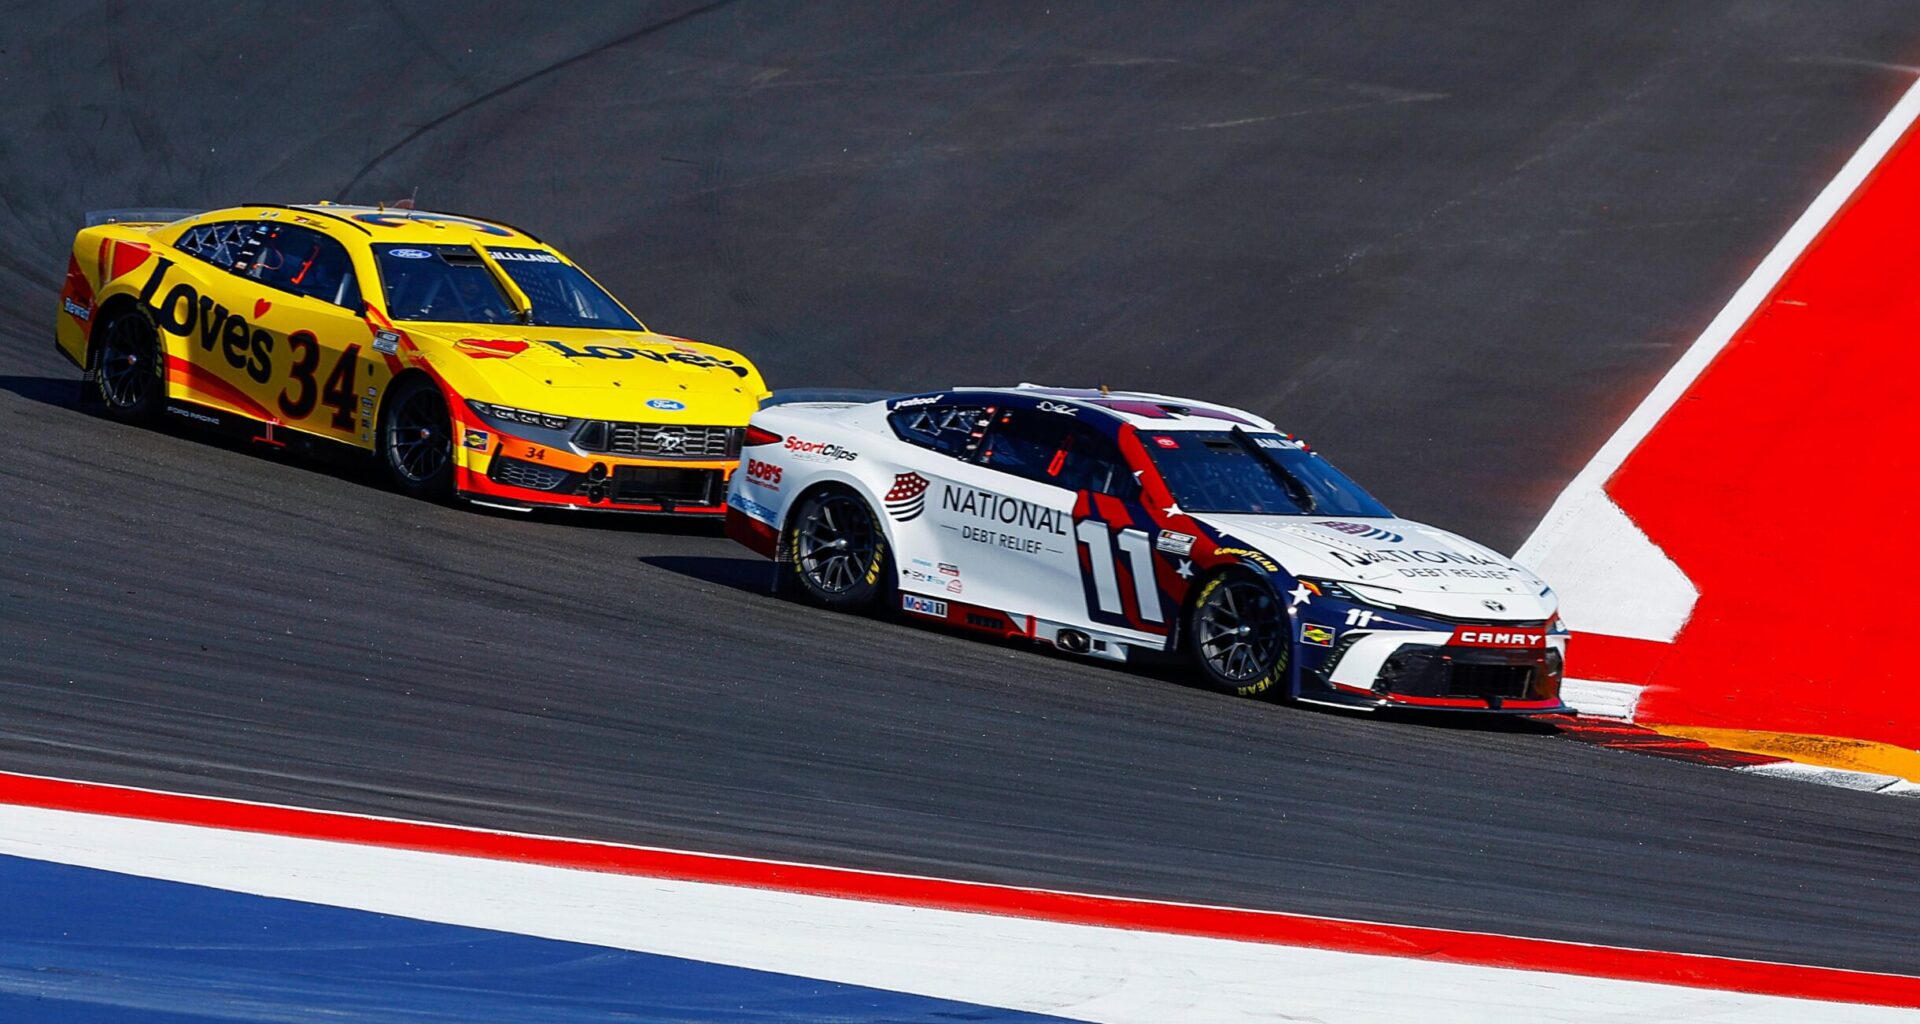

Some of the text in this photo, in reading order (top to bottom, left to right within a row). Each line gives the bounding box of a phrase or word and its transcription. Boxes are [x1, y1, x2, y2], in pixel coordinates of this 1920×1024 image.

[277, 329, 363, 434] 34
[167, 405, 220, 425] FORD RACING
[524, 446, 546, 461] 34
[747, 458, 784, 484] BOB'S
[942, 484, 1067, 536] NATIONAL
[961, 525, 1043, 555] DEBT RELIEF
[1213, 547, 1279, 572] GOODYEAR
[1075, 518, 1165, 624] 11
[1397, 568, 1512, 581] DEBT RELIEF
[904, 596, 934, 614] Mobil
[1344, 608, 1374, 628] 11
[1460, 631, 1543, 646] CAMRY
